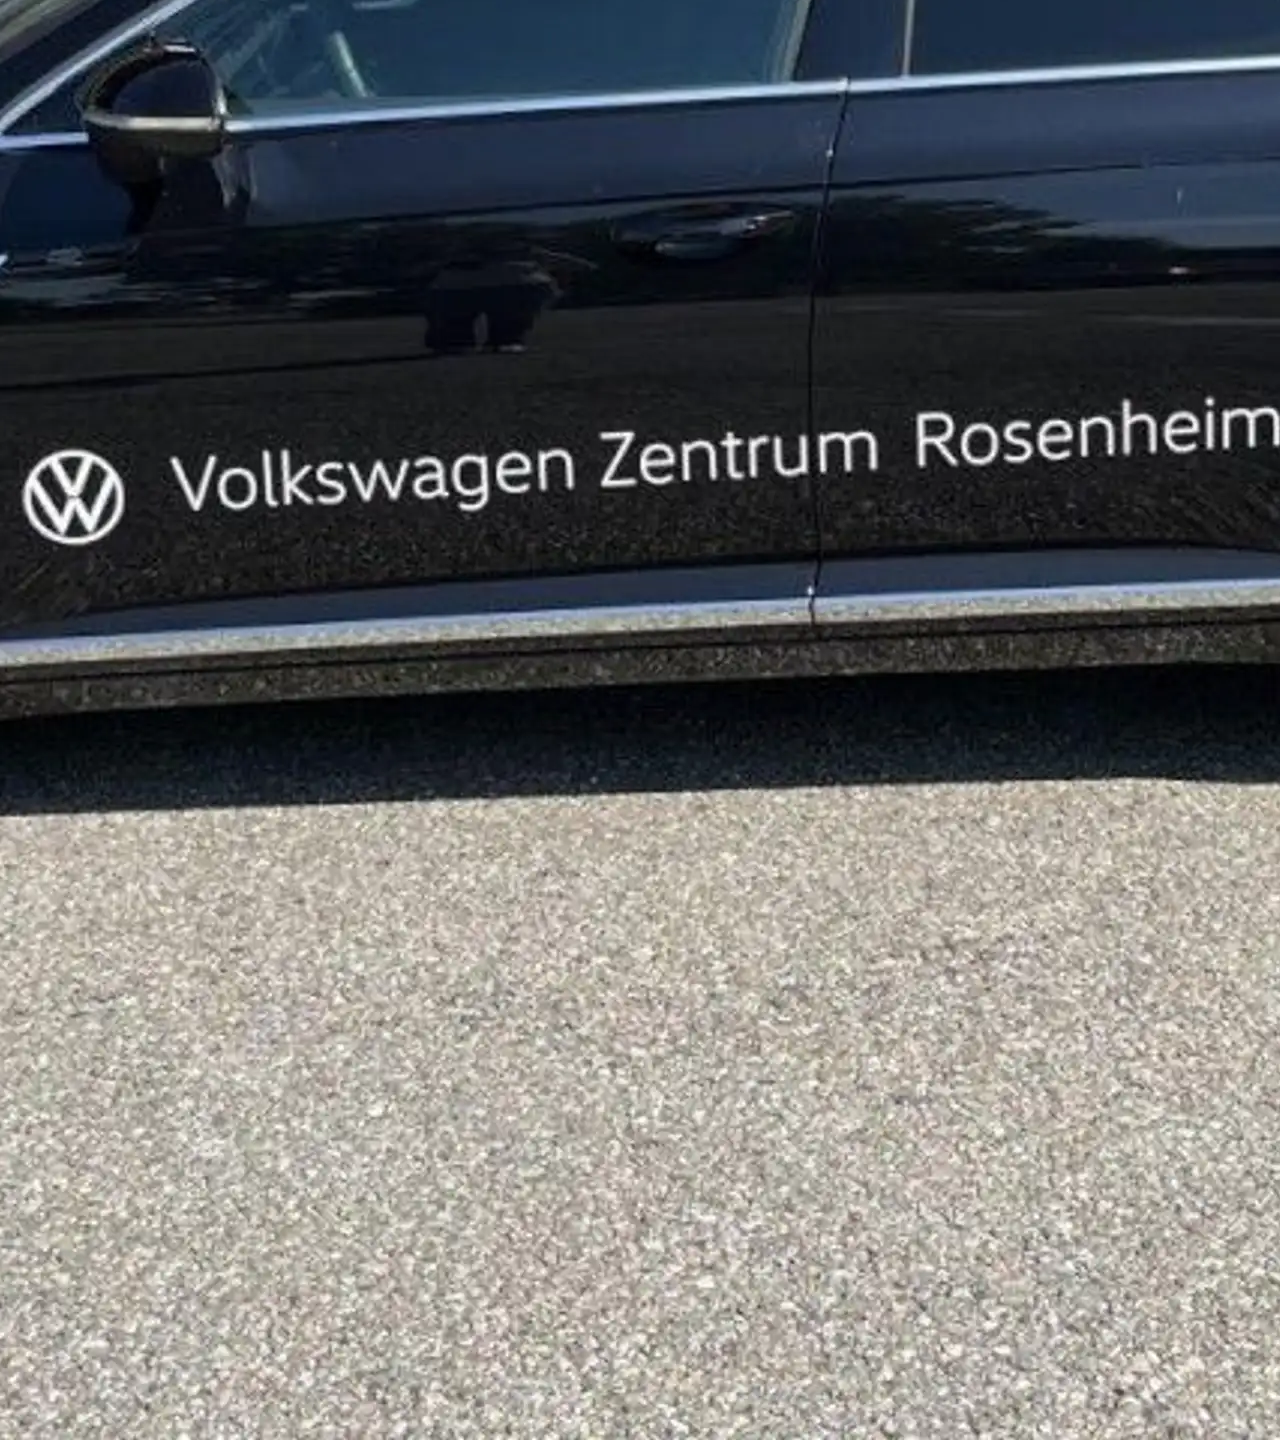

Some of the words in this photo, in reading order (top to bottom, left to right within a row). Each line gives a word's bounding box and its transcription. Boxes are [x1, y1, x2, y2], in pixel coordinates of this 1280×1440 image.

[23, 449, 125, 545] VW
[170, 448, 575, 512] Volkswagen
[600, 426, 878, 487] Zentrum
